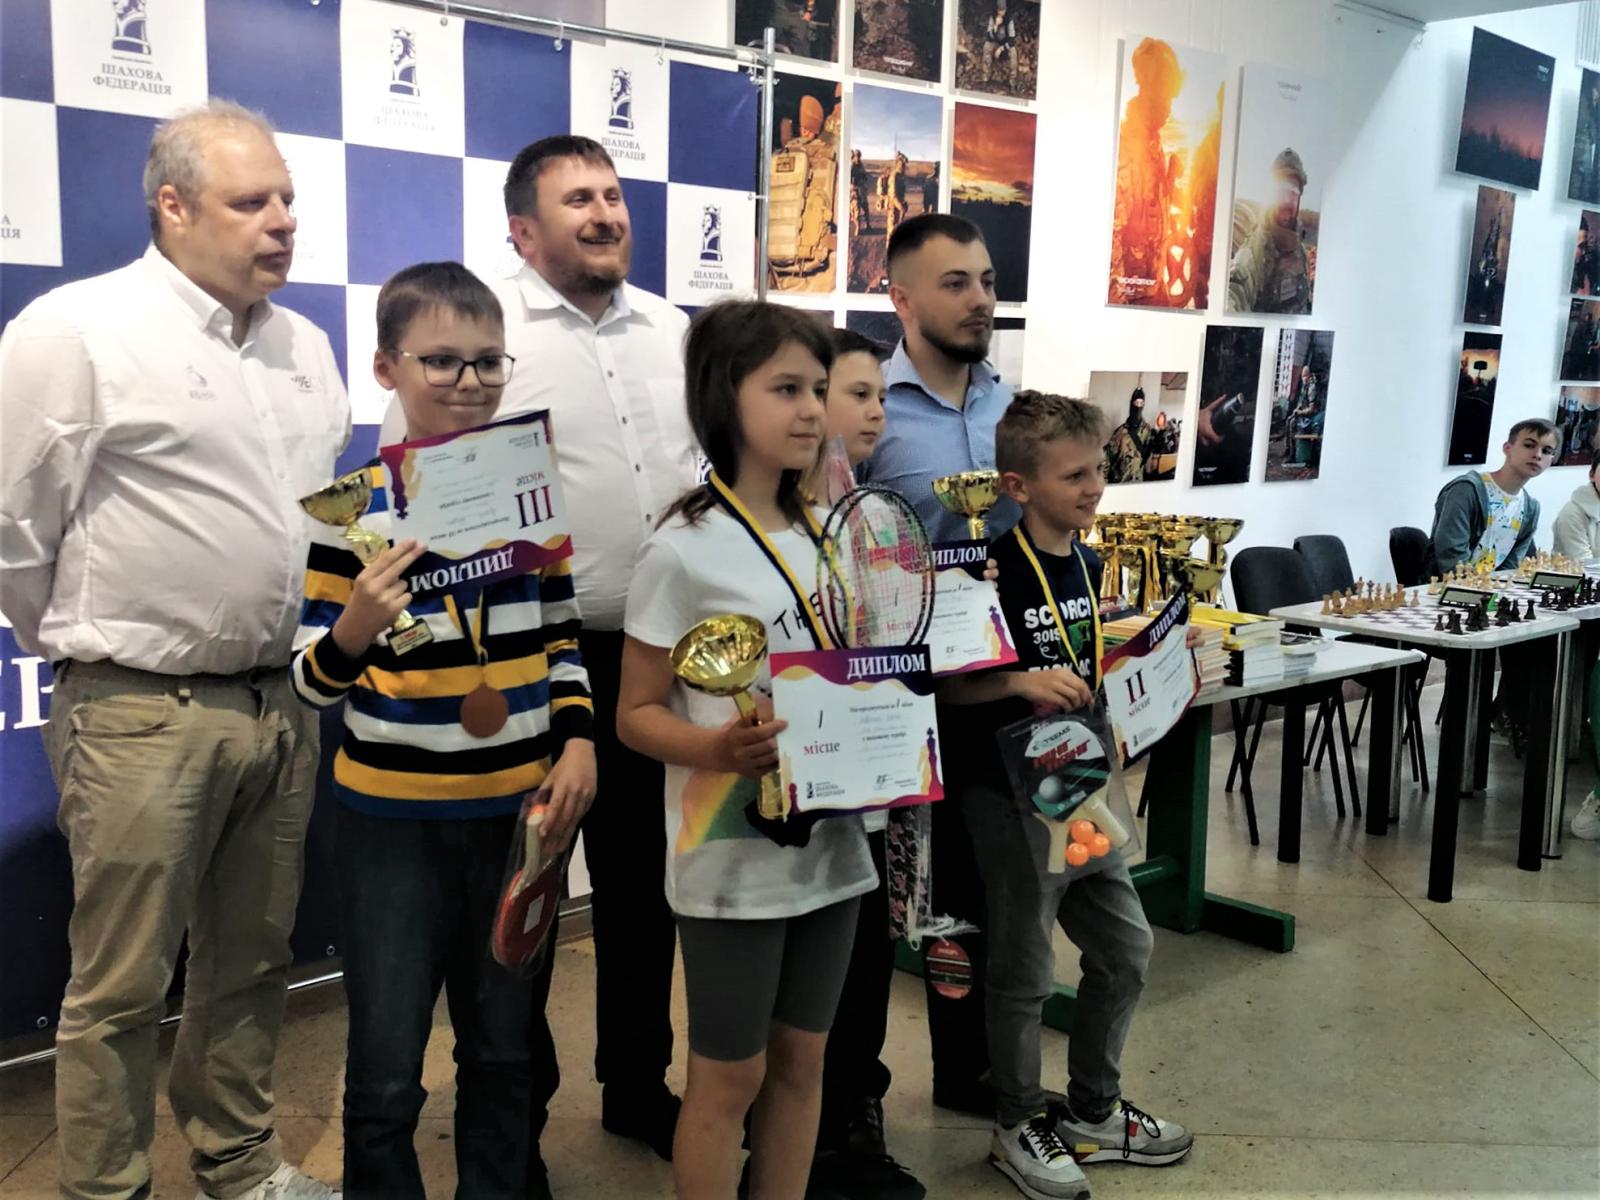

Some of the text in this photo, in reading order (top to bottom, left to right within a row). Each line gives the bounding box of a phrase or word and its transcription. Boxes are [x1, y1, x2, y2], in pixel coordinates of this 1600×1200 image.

[101, 63, 164, 81] ШАХОВА
[92, 75, 172, 95] ФЕДЕРАЦІЯ
[601, 137, 641, 151] ШАХОВА
[688, 279, 734, 290] ФЕДЕРАЦІЯ
[694, 270, 729, 281] ШАХОВА
[411, 547, 514, 593] ДИПЛОМ
[1149, 591, 1187, 649] ДИПЛОМ
[847, 653, 926, 680] ДИПЛОМ
[803, 740, 841, 756] місце
